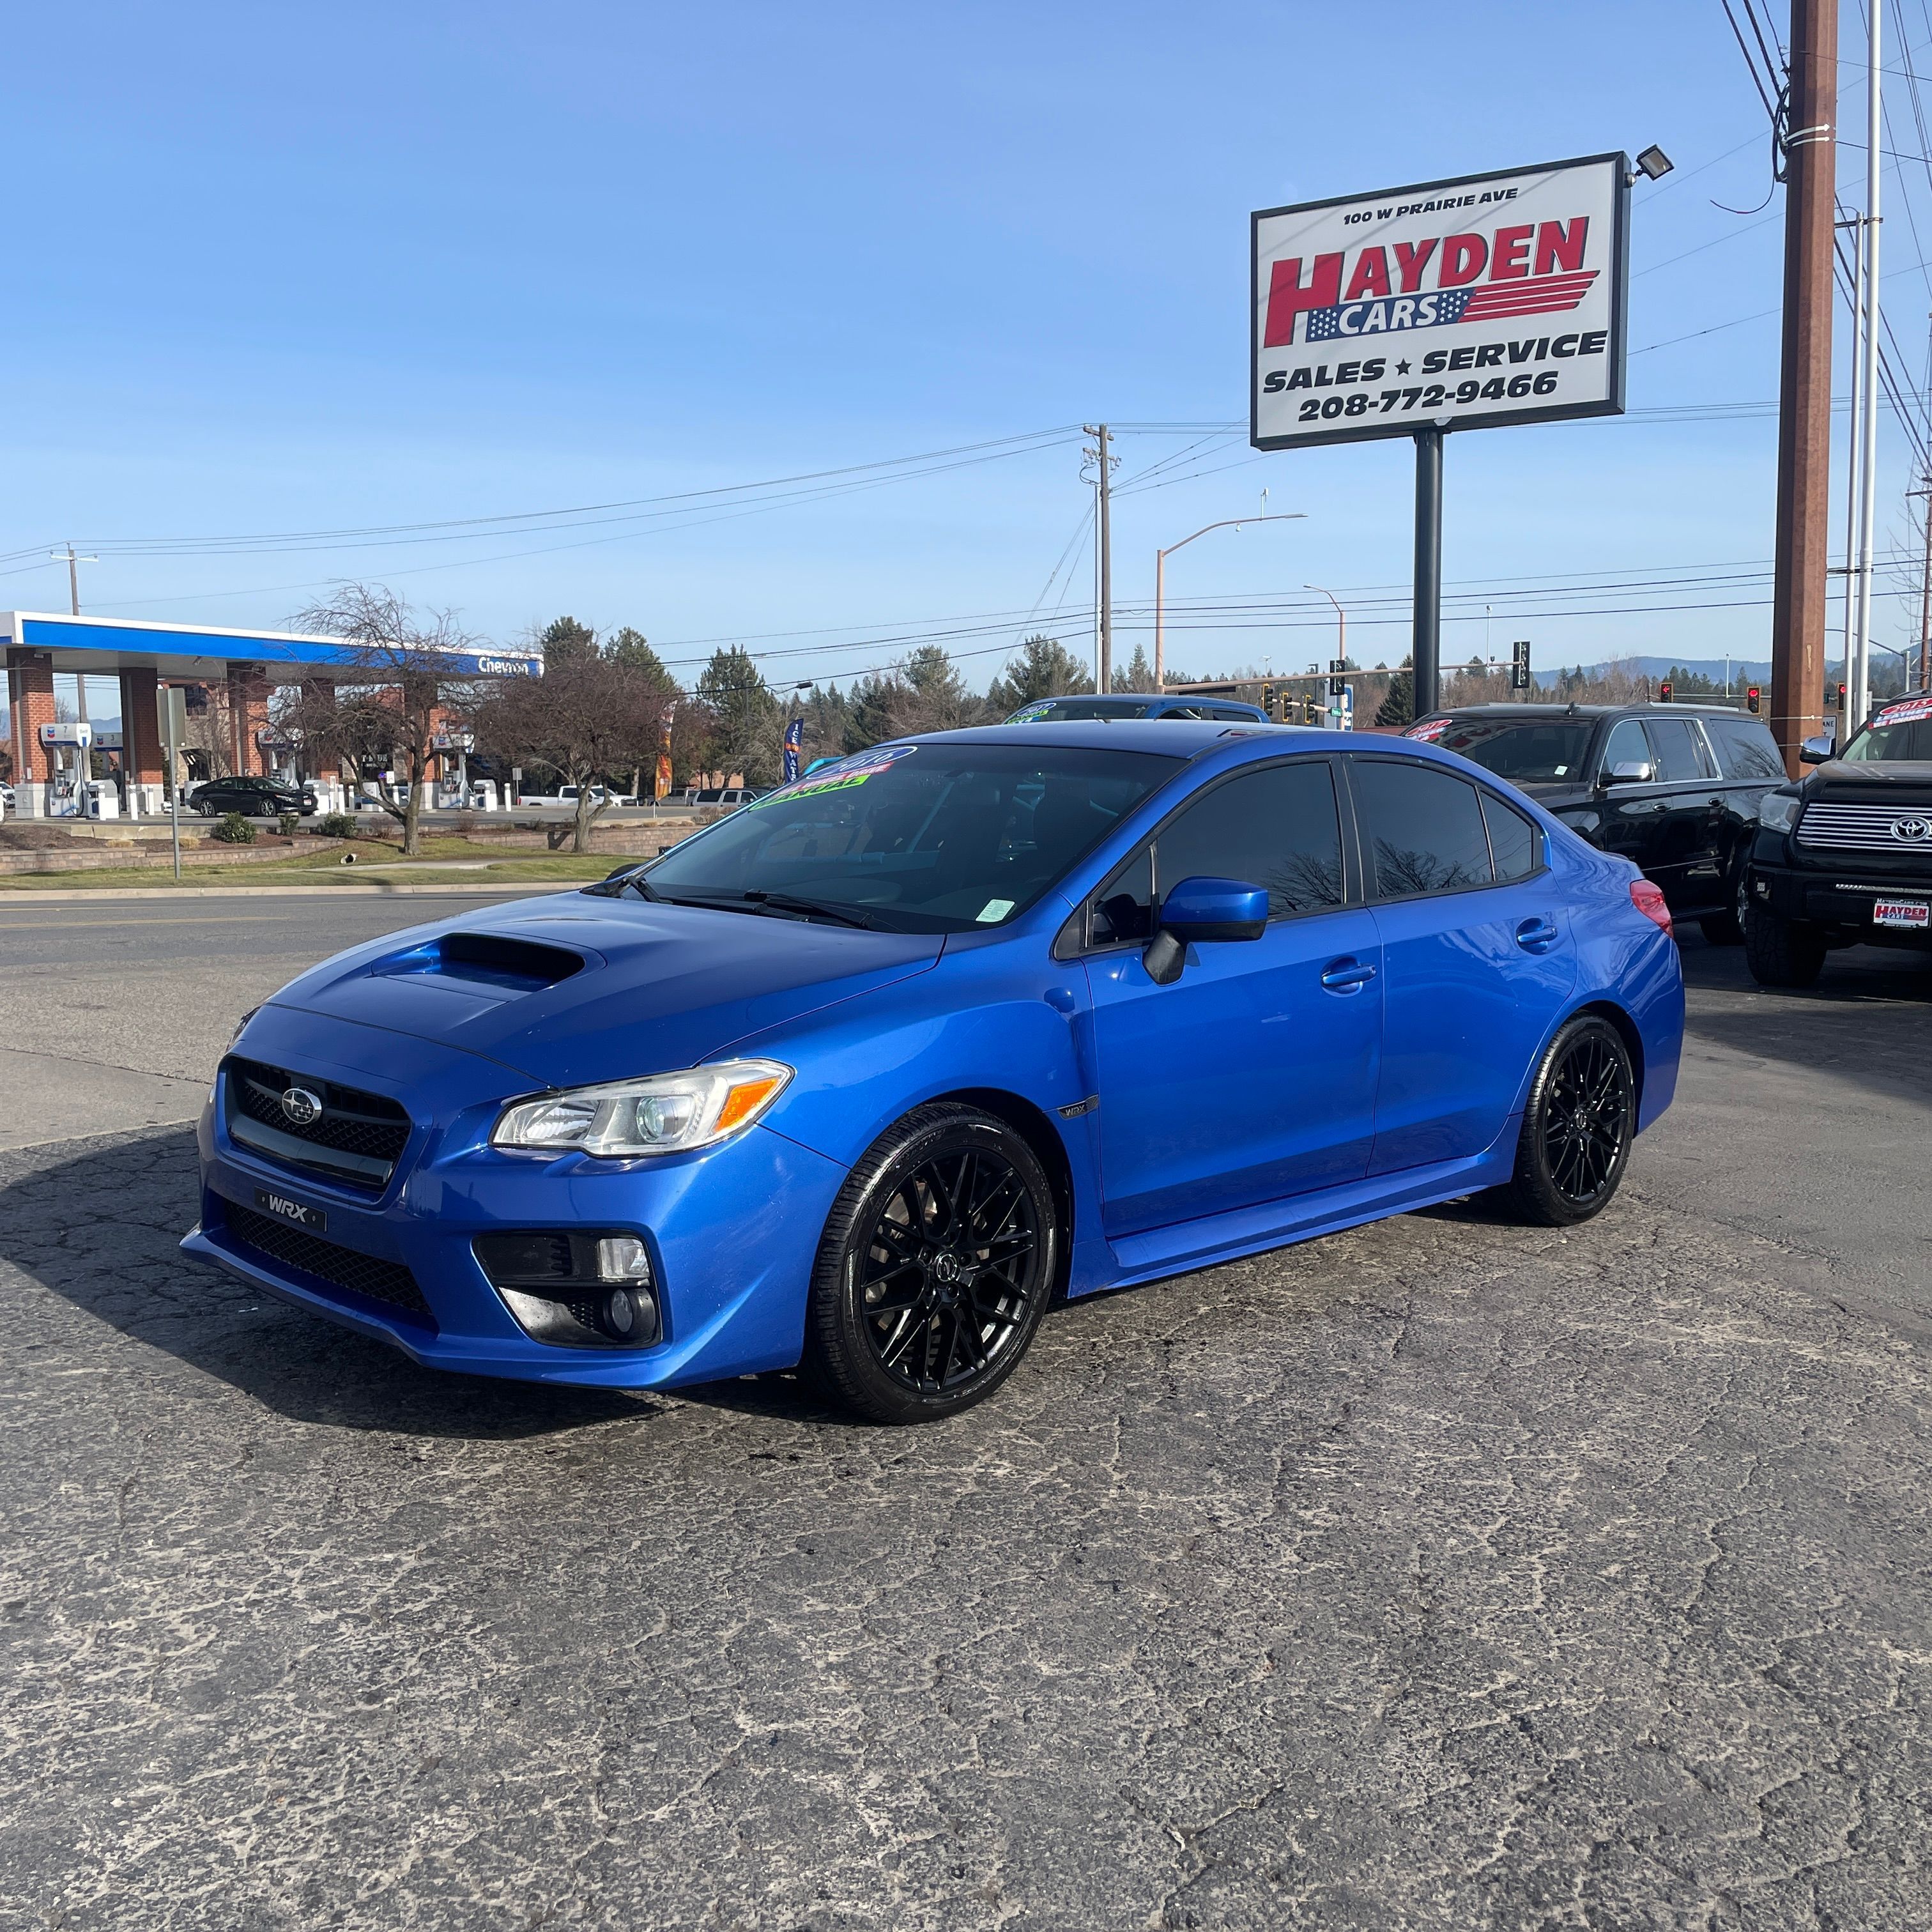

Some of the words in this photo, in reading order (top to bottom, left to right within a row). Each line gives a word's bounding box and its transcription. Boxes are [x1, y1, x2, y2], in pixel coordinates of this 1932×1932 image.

[1344, 211, 1372, 225] 100
[1377, 208, 1393, 220] W
[1396, 194, 1475, 217] PRAIRIE
[1478, 188, 1518, 203] AVE
[1264, 216, 1590, 348] HAYDEN
[1338, 295, 1439, 335] CARS
[1263, 358, 1386, 393] SALES
[1422, 330, 1608, 374] SERVICE
[1298, 371, 1559, 422] 208-772-9466
[479, 657, 528, 675] Chevron
[1891, 699, 1928, 713] 2015
[1875, 905, 1928, 918] HAYDEN
[1065, 1105, 1085, 1116] WRX
[269, 1194, 308, 1223] WRX
